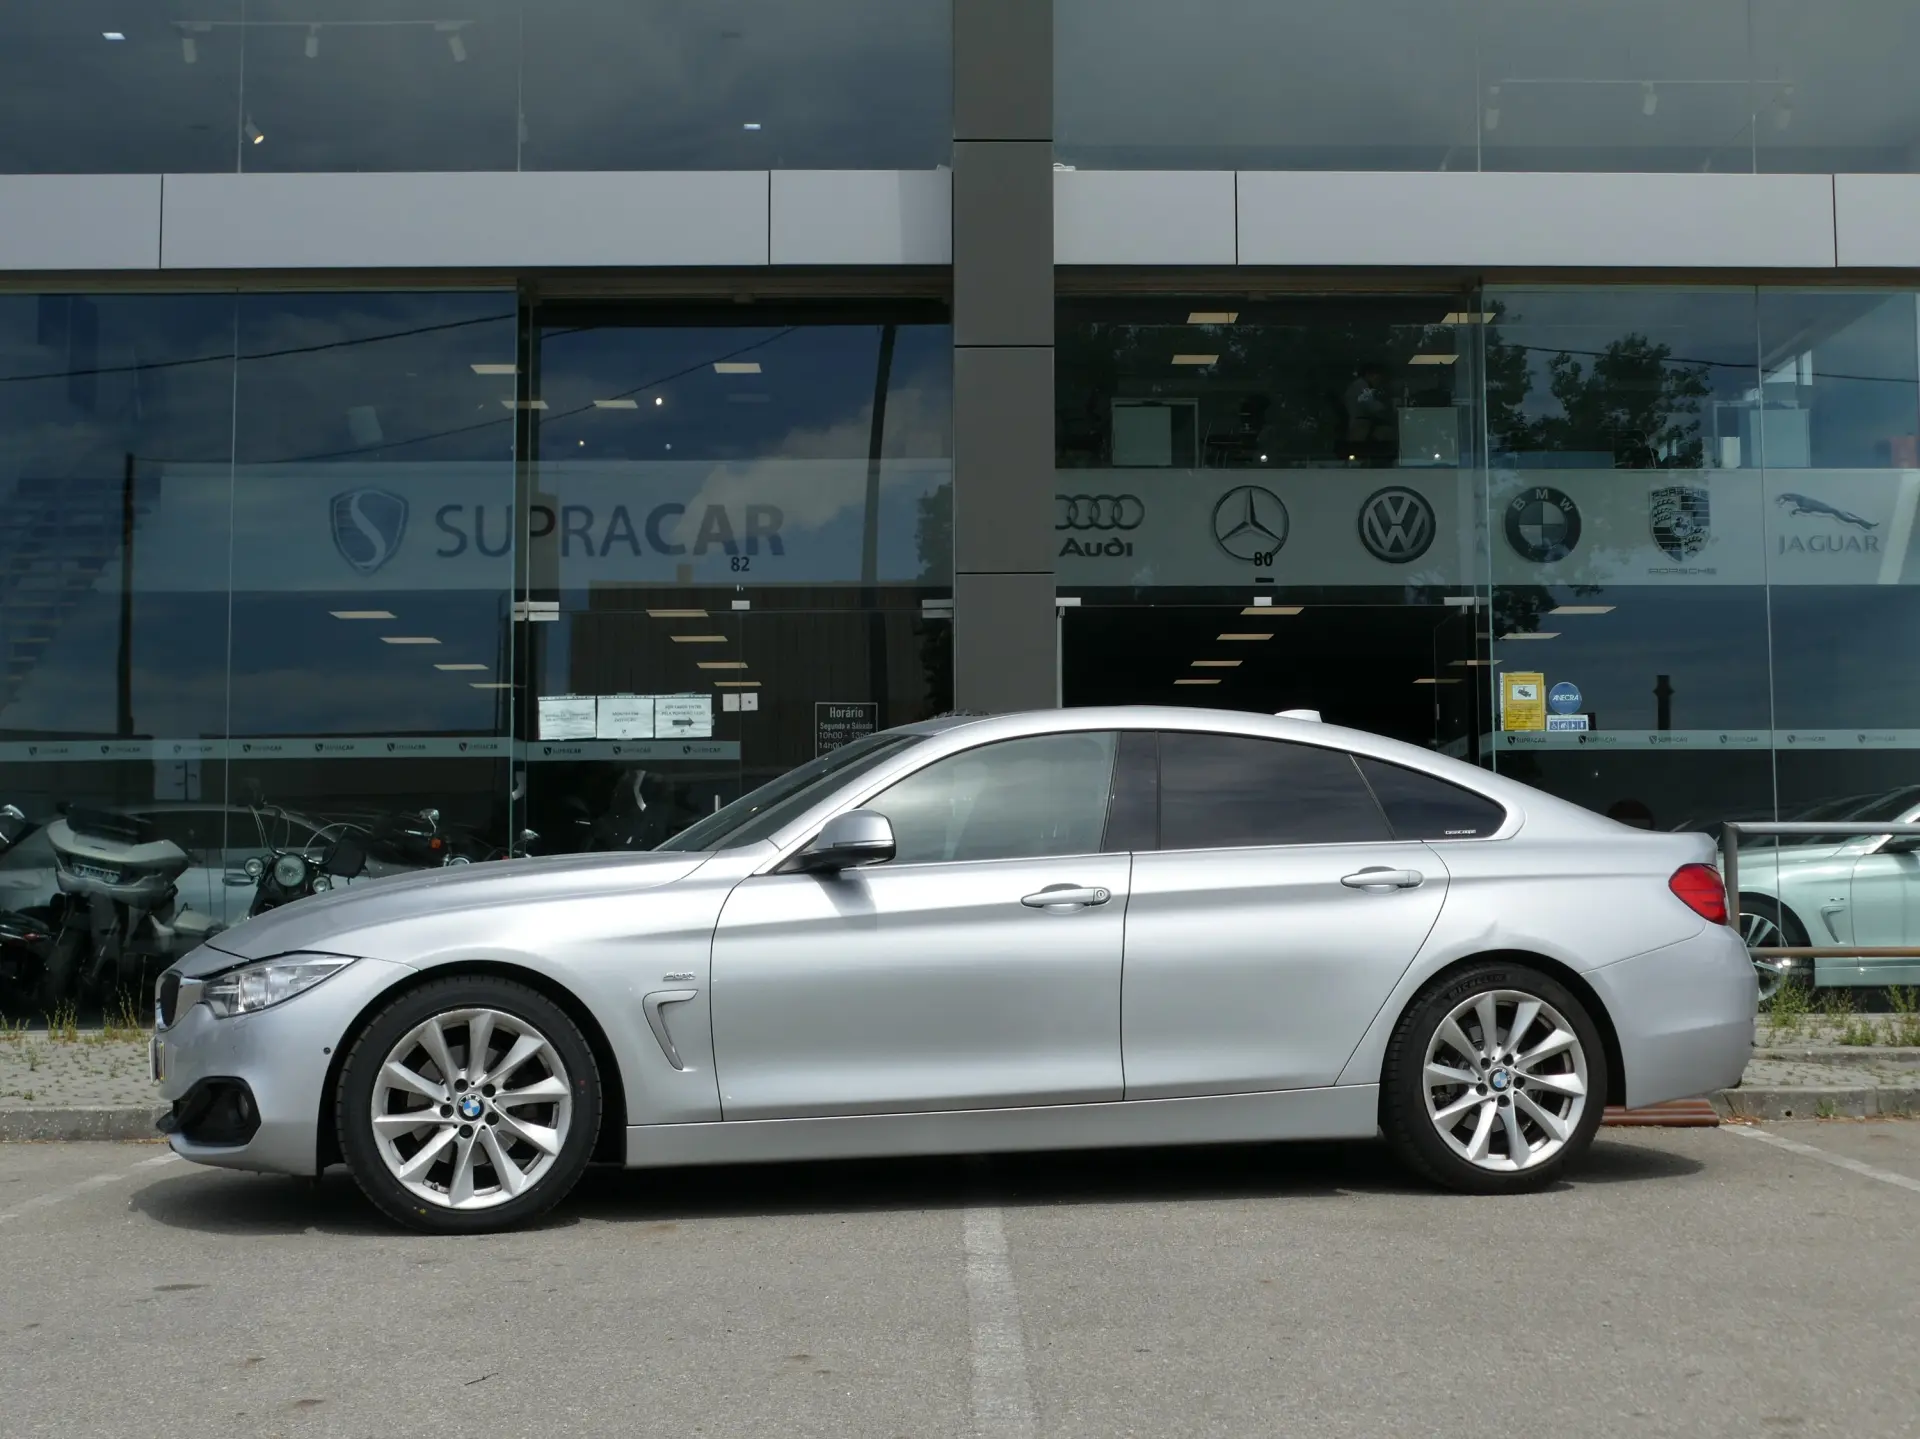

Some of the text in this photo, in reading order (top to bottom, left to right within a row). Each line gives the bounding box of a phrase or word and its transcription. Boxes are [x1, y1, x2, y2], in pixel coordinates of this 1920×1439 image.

[1511, 488, 1574, 512] BMW
[435, 502, 785, 558] SUPRACAR
[1058, 537, 1133, 557] Audi
[1778, 534, 1881, 555] JAGUAR
[731, 556, 750, 572] 82
[1253, 551, 1273, 567] 80
[1647, 567, 1717, 575] PORSCHE
[829, 706, 864, 718] Horário
[819, 731, 843, 739] 10h00
